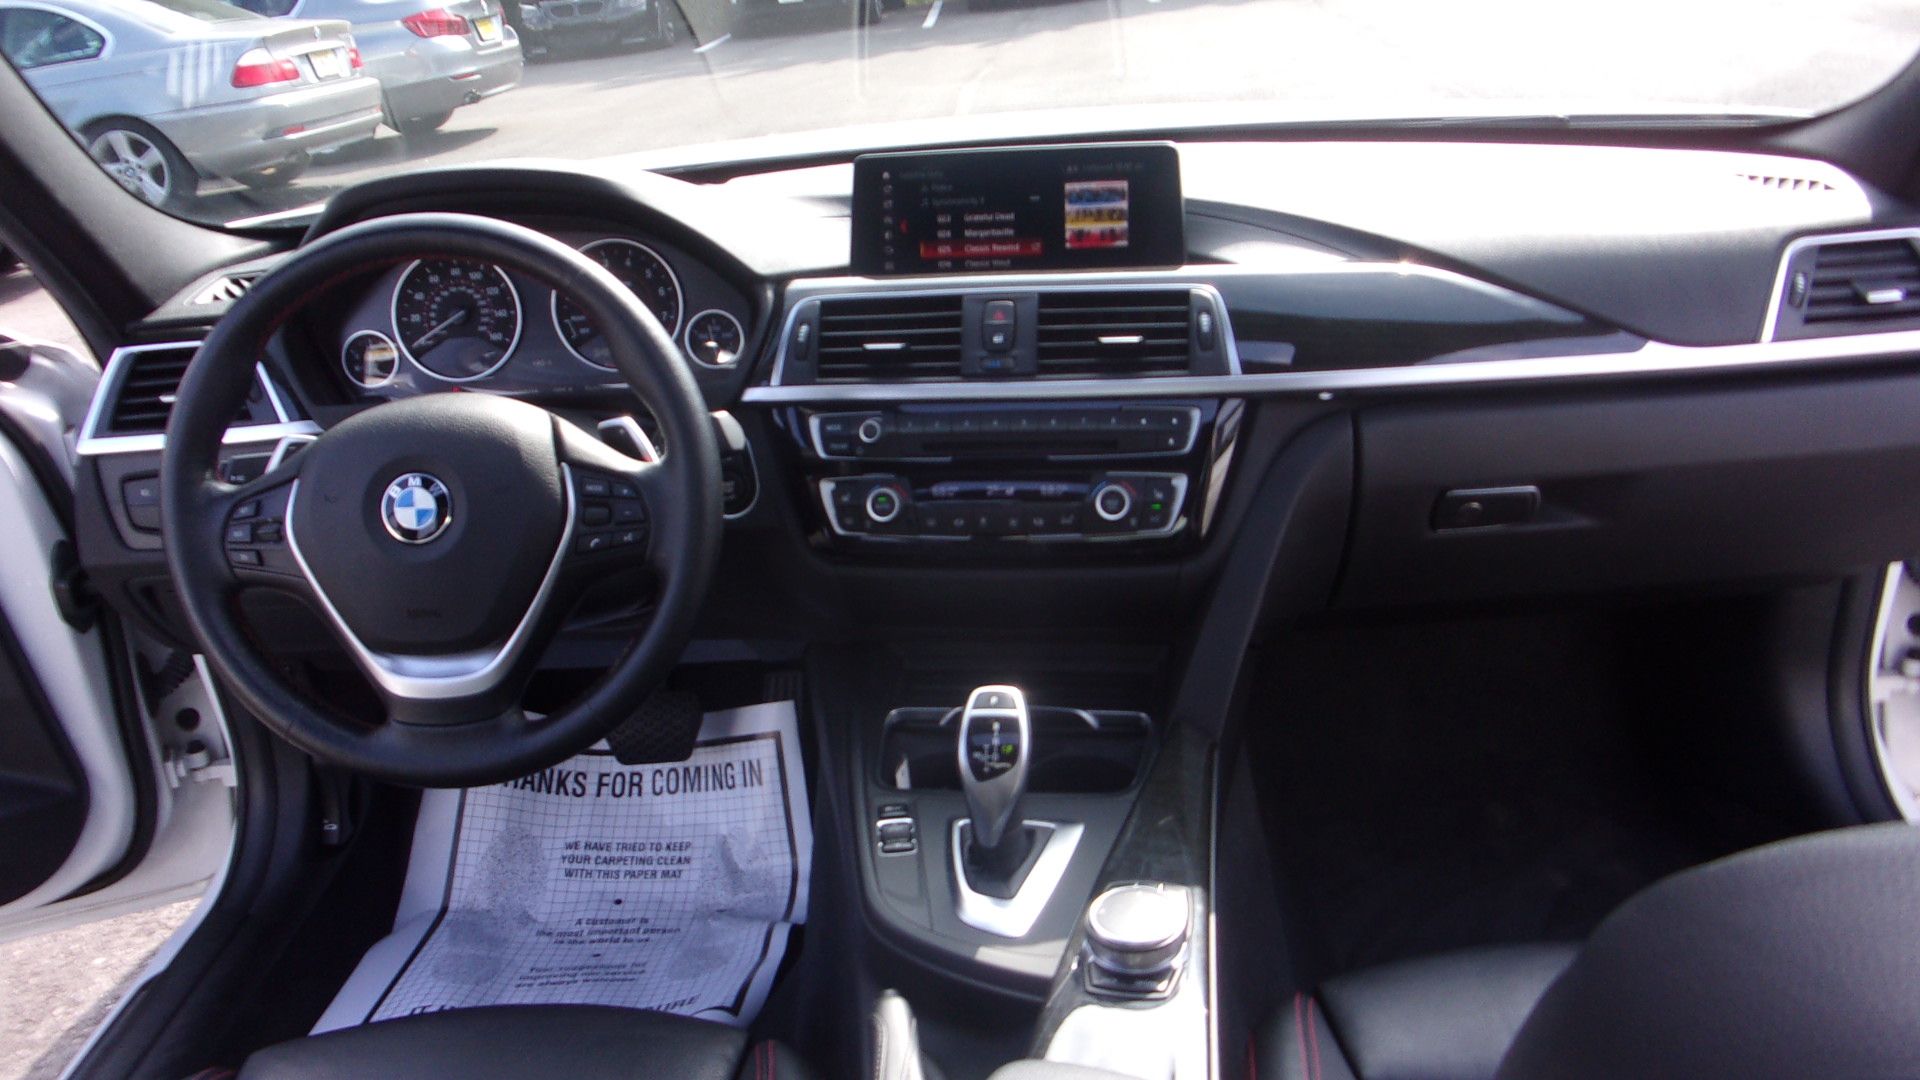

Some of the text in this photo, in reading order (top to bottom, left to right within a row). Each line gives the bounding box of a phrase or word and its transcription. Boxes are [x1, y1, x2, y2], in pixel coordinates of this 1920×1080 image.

[501, 759, 764, 798] ANKS FOR COMING IN
[565, 841, 691, 851] WE HAVE TRIED TO KEEP
[561, 854, 691, 866] YOUR CARPETING CLEAN
[564, 869, 683, 879] WITH THIS PAPER MAT
